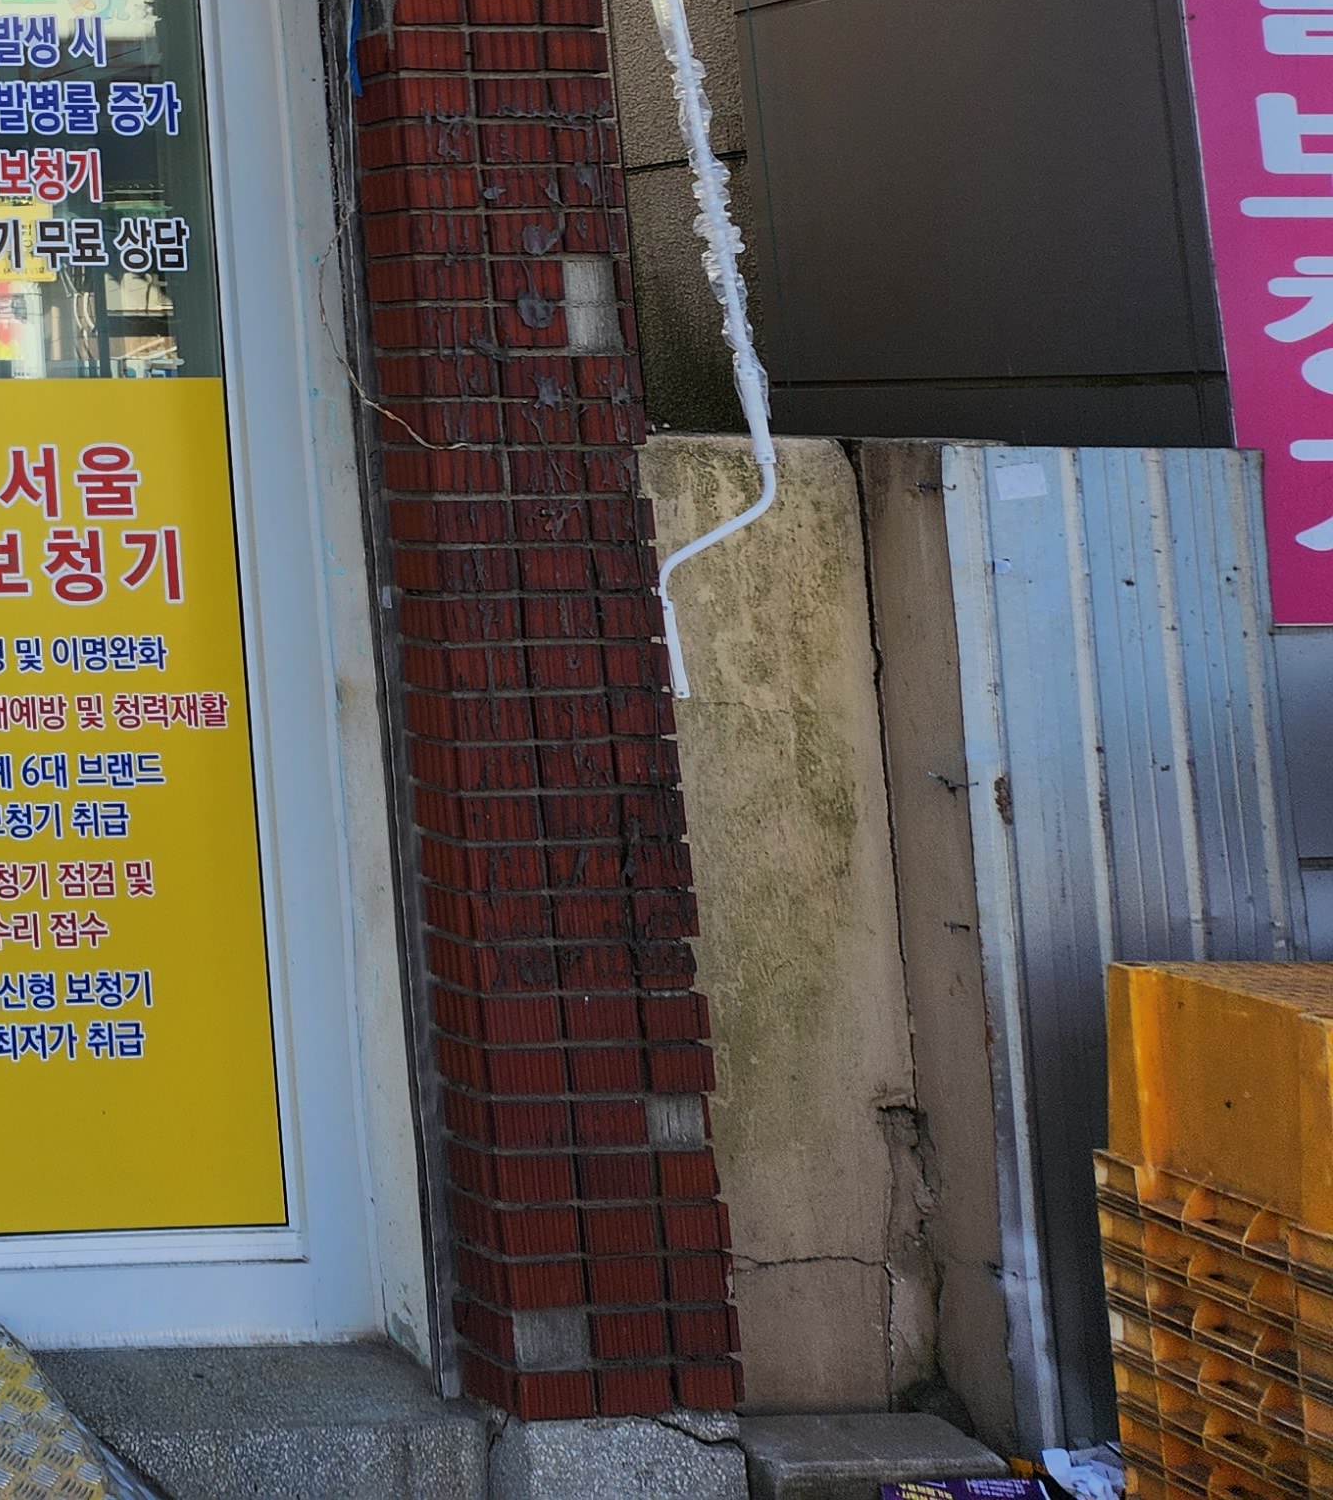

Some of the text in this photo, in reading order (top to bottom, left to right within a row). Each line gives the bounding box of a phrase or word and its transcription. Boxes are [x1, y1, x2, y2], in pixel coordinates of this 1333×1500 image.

[71, 15, 107, 67] 시
[107, 82, 180, 137] 증가
[36, 218, 109, 272] 무료
[115, 218, 190, 272] 상담
[16, 637, 44, 672] 및
[51, 636, 168, 672] 이명완화
[77, 694, 104, 730] 및
[113, 692, 229, 729] 청력재활
[21, 753, 67, 789] 6대
[77, 752, 165, 788] 브랜드
[72, 802, 130, 838] 취급
[57, 861, 116, 898] 점검
[125, 860, 154, 896] 및
[49, 911, 108, 948] 접수
[65, 970, 153, 1008] 보청기
[86, 1021, 144, 1059] 취급
